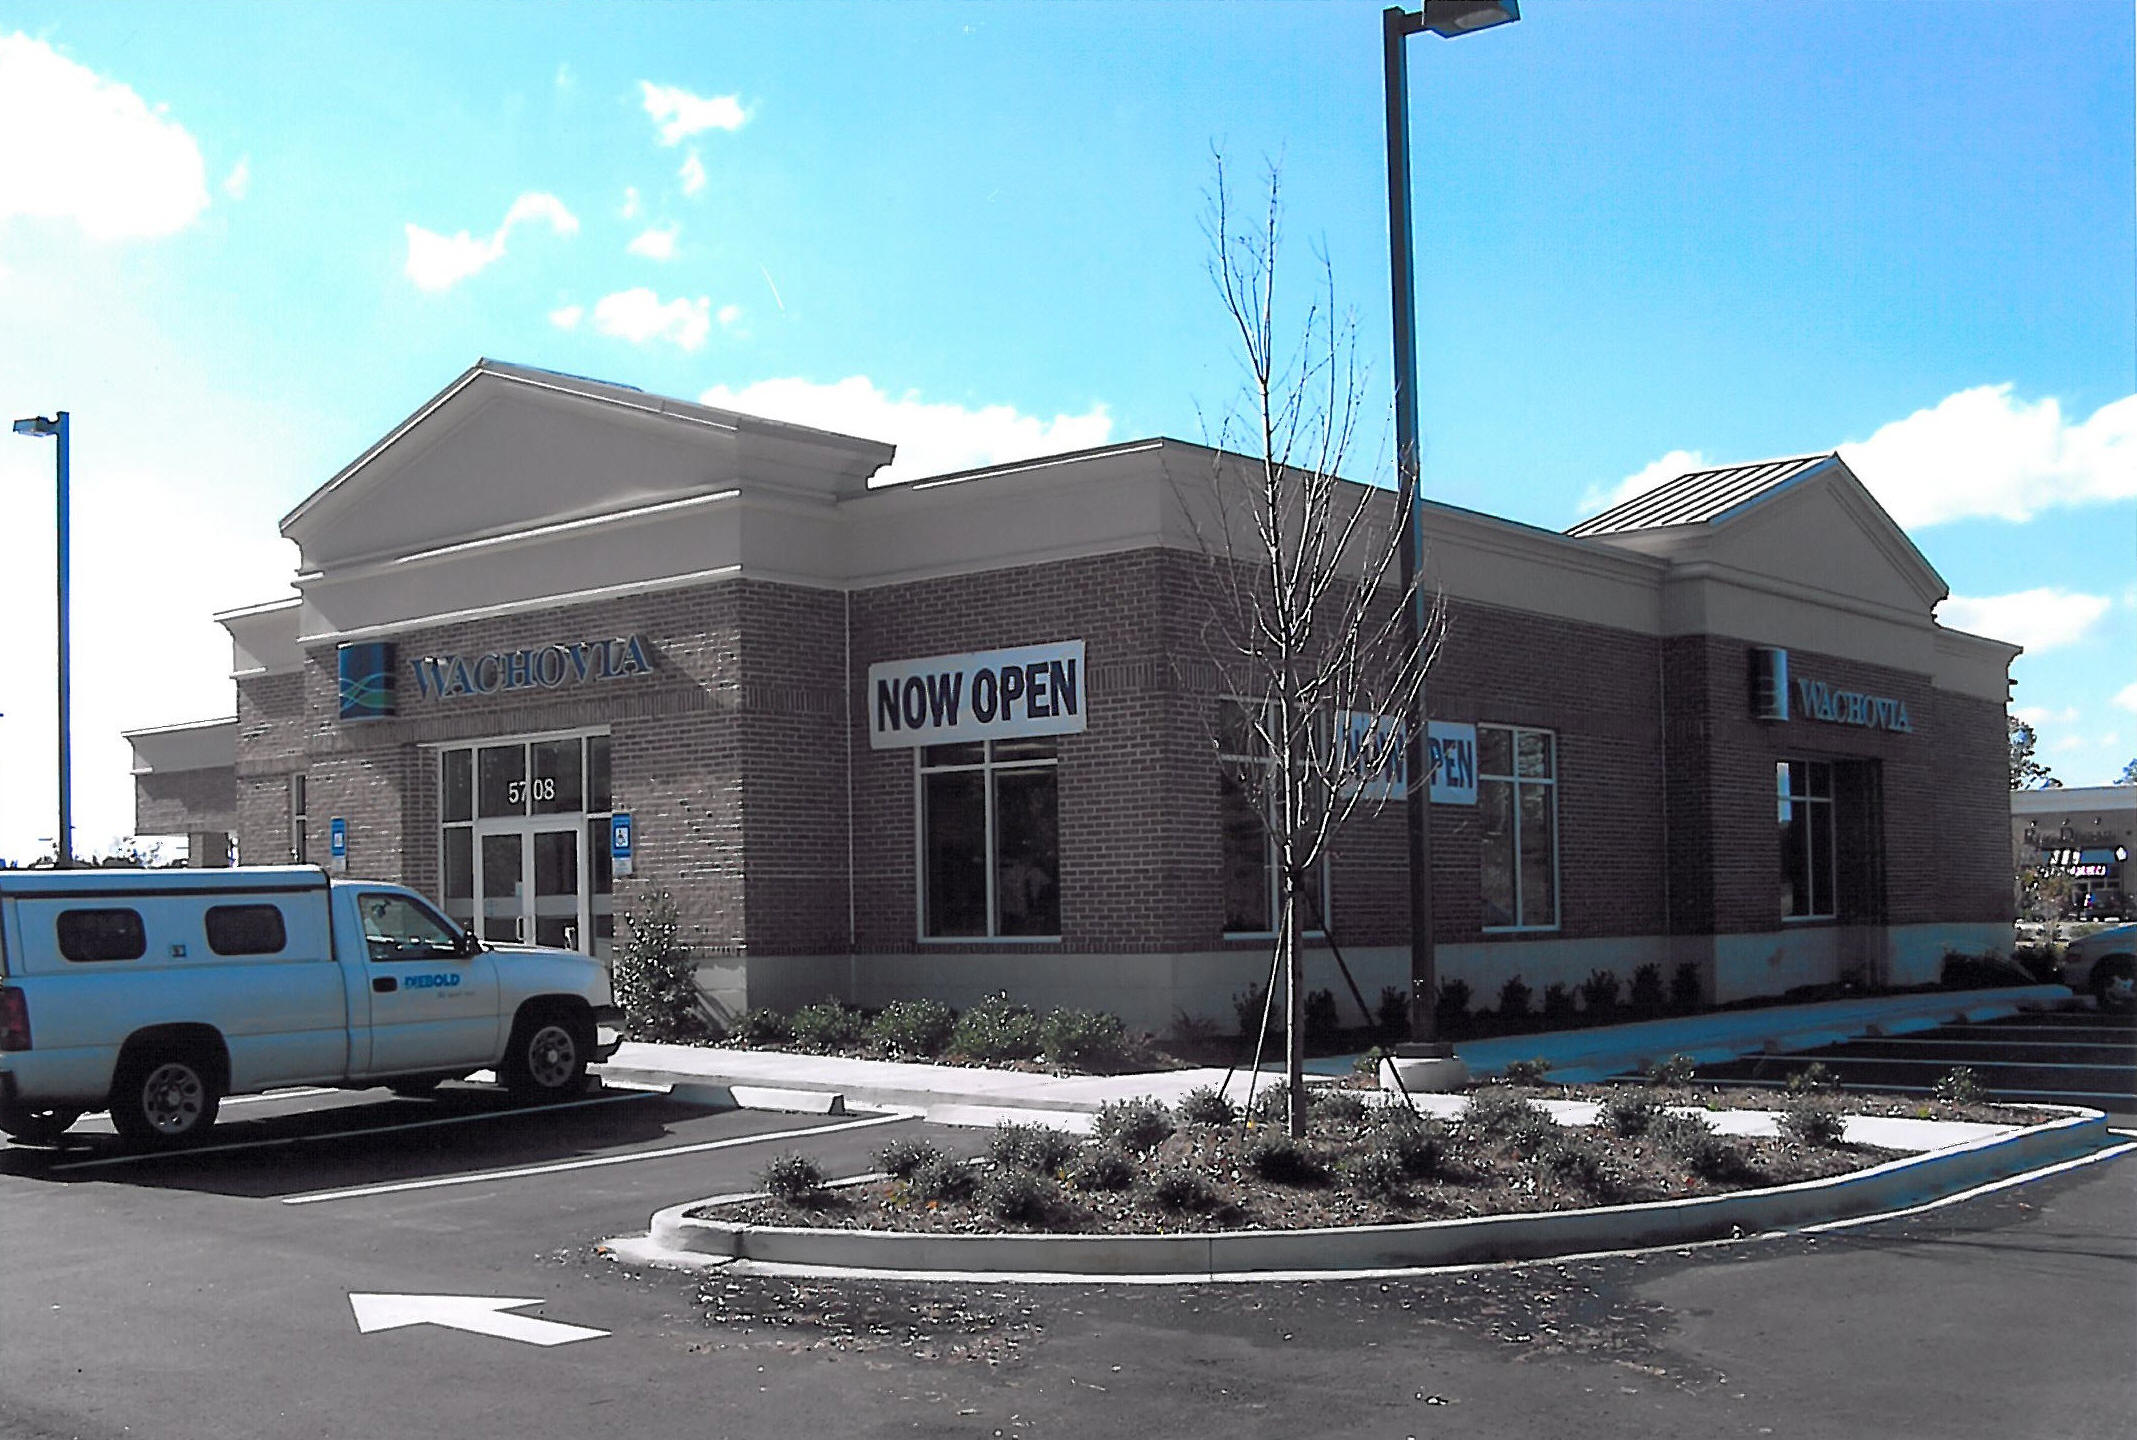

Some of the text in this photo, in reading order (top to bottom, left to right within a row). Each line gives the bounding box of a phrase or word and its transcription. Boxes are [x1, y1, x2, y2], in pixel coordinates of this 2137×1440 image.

[410, 633, 652, 700] WACHOVIA
[877, 658, 1077, 732] NOW OPEN
[1798, 678, 1913, 733] WACHOVIA
[1427, 737, 1473, 789] PEN
[508, 778, 555, 803] 5708
[404, 973, 461, 989] DIEBOLD
